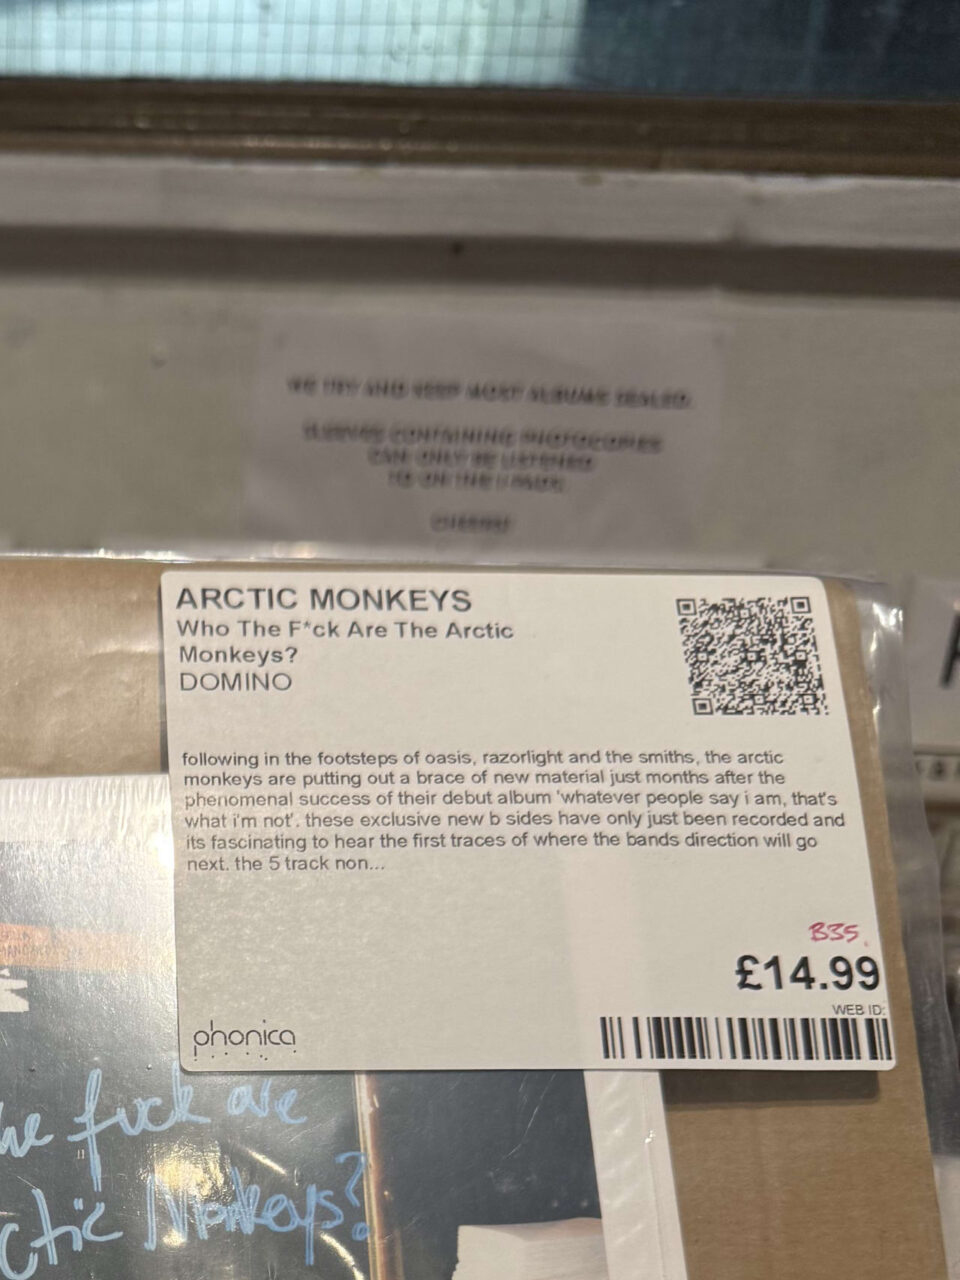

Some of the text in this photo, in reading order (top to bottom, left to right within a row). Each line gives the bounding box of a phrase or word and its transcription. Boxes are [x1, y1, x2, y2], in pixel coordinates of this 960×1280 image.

[176, 587, 472, 613] ARCTIC MONKEYS
[177, 619, 229, 637] Who
[238, 619, 281, 638] The
[347, 620, 387, 638] Are
[394, 621, 437, 639] The
[446, 621, 514, 639] Arctic
[180, 645, 298, 668] Monkeys?
[180, 672, 292, 692] DOMINO
[182, 749, 783, 770] following in the footsteps of oasis, razorlight and the smiths, the arctic
[184, 769, 785, 790] monkeys are putting out a brace of new material just months after the
[185, 789, 837, 810] phenomenal success of their debut album 'whatever people say i am, that's
[185, 813, 227, 828] what
[232, 813, 257, 828] i'm
[306, 812, 354, 828] these
[360, 811, 441, 827] exclusive
[448, 814, 483, 826] new
[490, 811, 500, 826] b
[506, 810, 552, 826] sides
[558, 810, 600, 825] have
[606, 810, 641, 829] only
[646, 811, 678, 829] just
[683, 810, 726, 827] been
[732, 812, 808, 827] recorded
[813, 812, 844, 828] and
[186, 831, 817, 853] its fascinating to hear the first traces of where the bands direction will go
[187, 855, 385, 871] next. the 5 track non...
[735, 954, 880, 991] £14.99
[832, 1004, 886, 1016] WEB ID:
[193, 1019, 296, 1056] phonica
[68, 1060, 210, 1191] fuck
